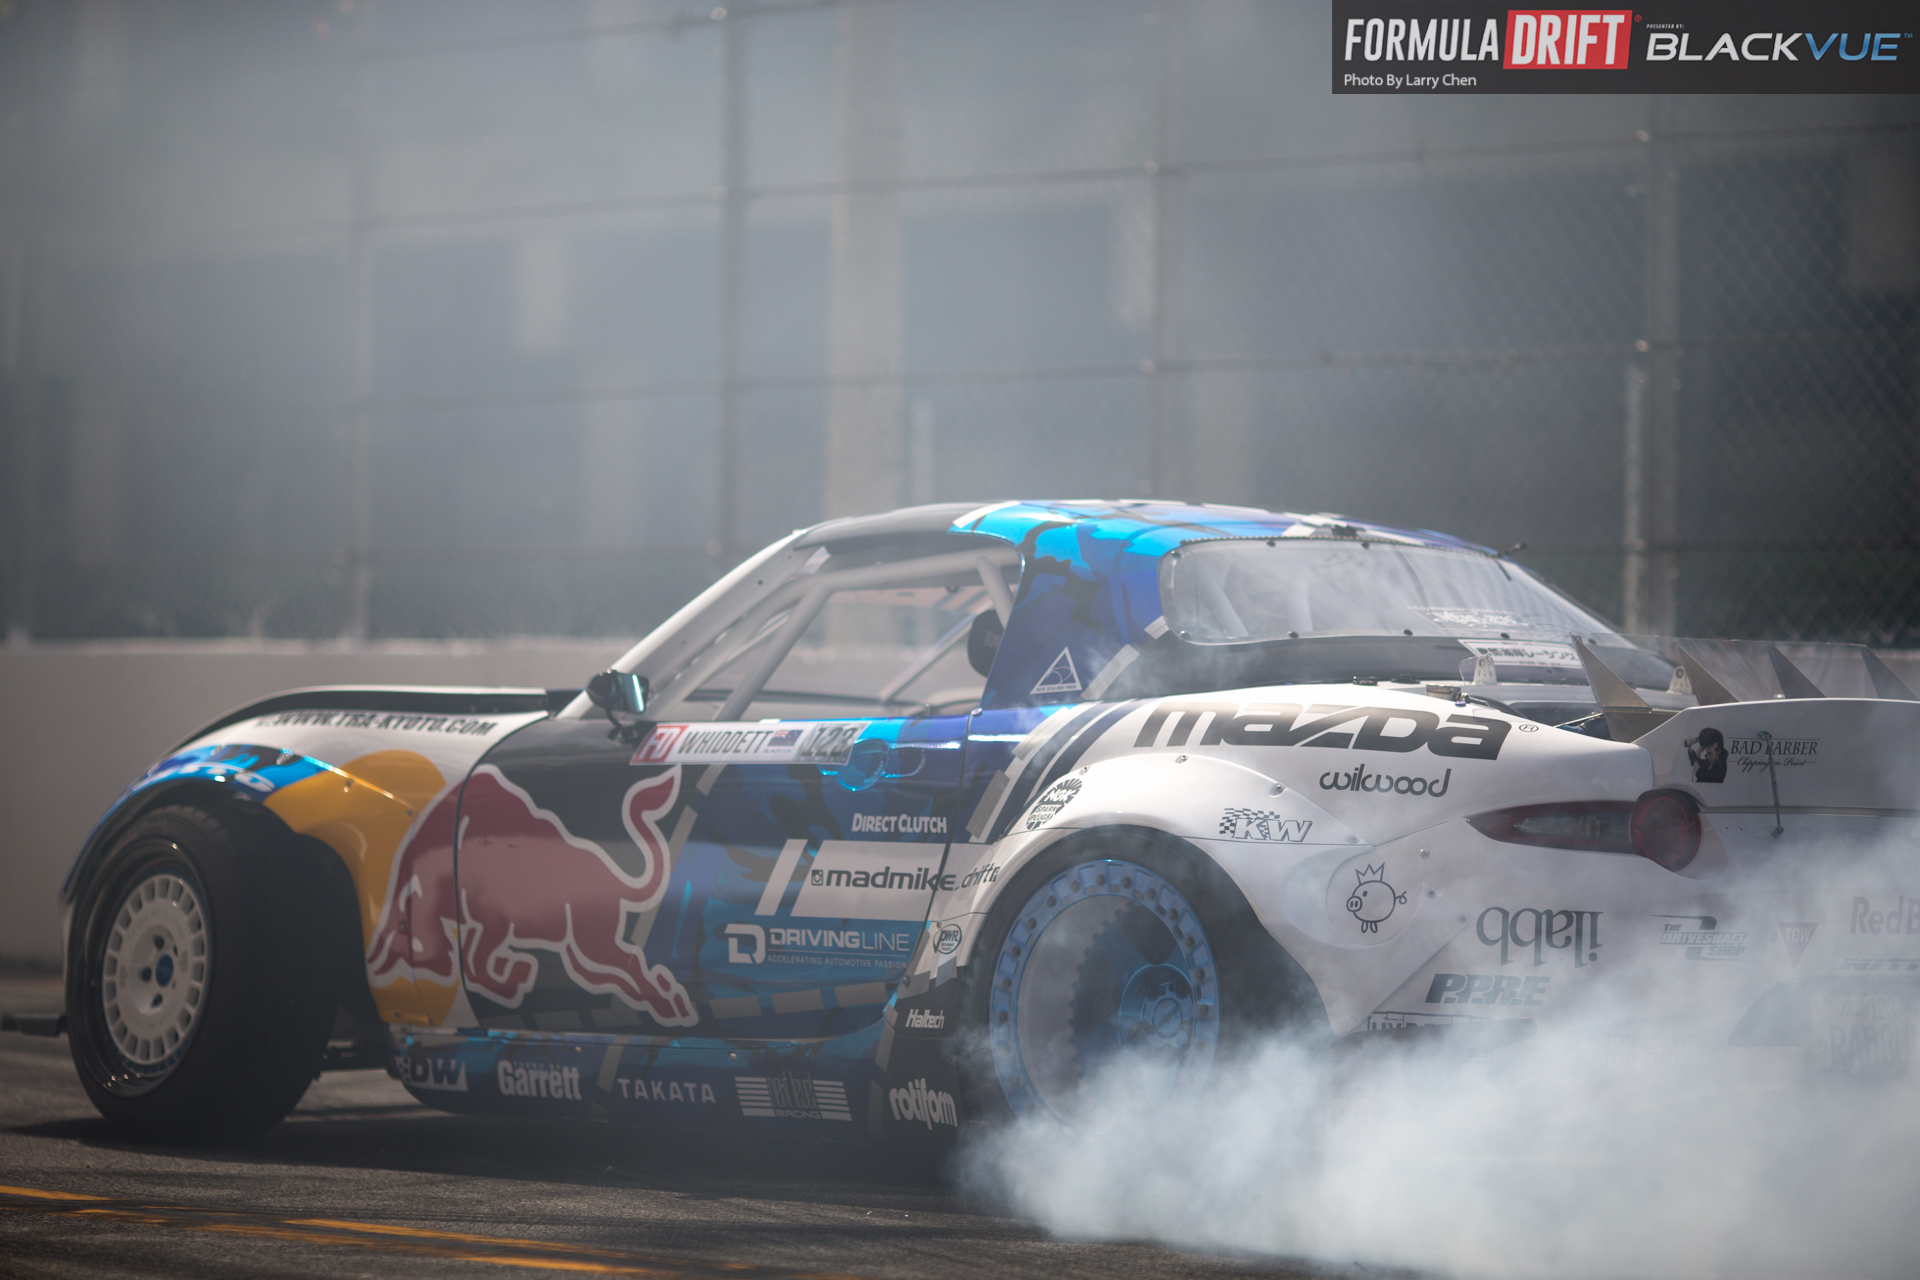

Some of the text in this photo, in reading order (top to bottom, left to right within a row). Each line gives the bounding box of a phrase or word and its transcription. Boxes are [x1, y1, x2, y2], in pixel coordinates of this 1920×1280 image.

[678, 729, 775, 754] WHIDDETT
[801, 726, 858, 757] 123
[1730, 740, 1818, 755] BAD BARBER
[1319, 764, 1452, 798] wilwood
[1043, 789, 1077, 802] NGK
[1233, 819, 1312, 842] KW
[1664, 924, 1682, 932] THE
[1785, 927, 1812, 943] TOW
[1660, 932, 1748, 945] DRIVESHAFT
[1707, 945, 1745, 957] SHOP
[767, 954, 908, 969] ACCELERATING AUTOMOTIVE PASSION
[905, 1009, 945, 1029] Haltech
[497, 1059, 583, 1101] Garrett
[617, 1078, 716, 1104] TAKATA
[889, 1078, 958, 1131] rotiform
[776, 1109, 821, 1119] RACING
